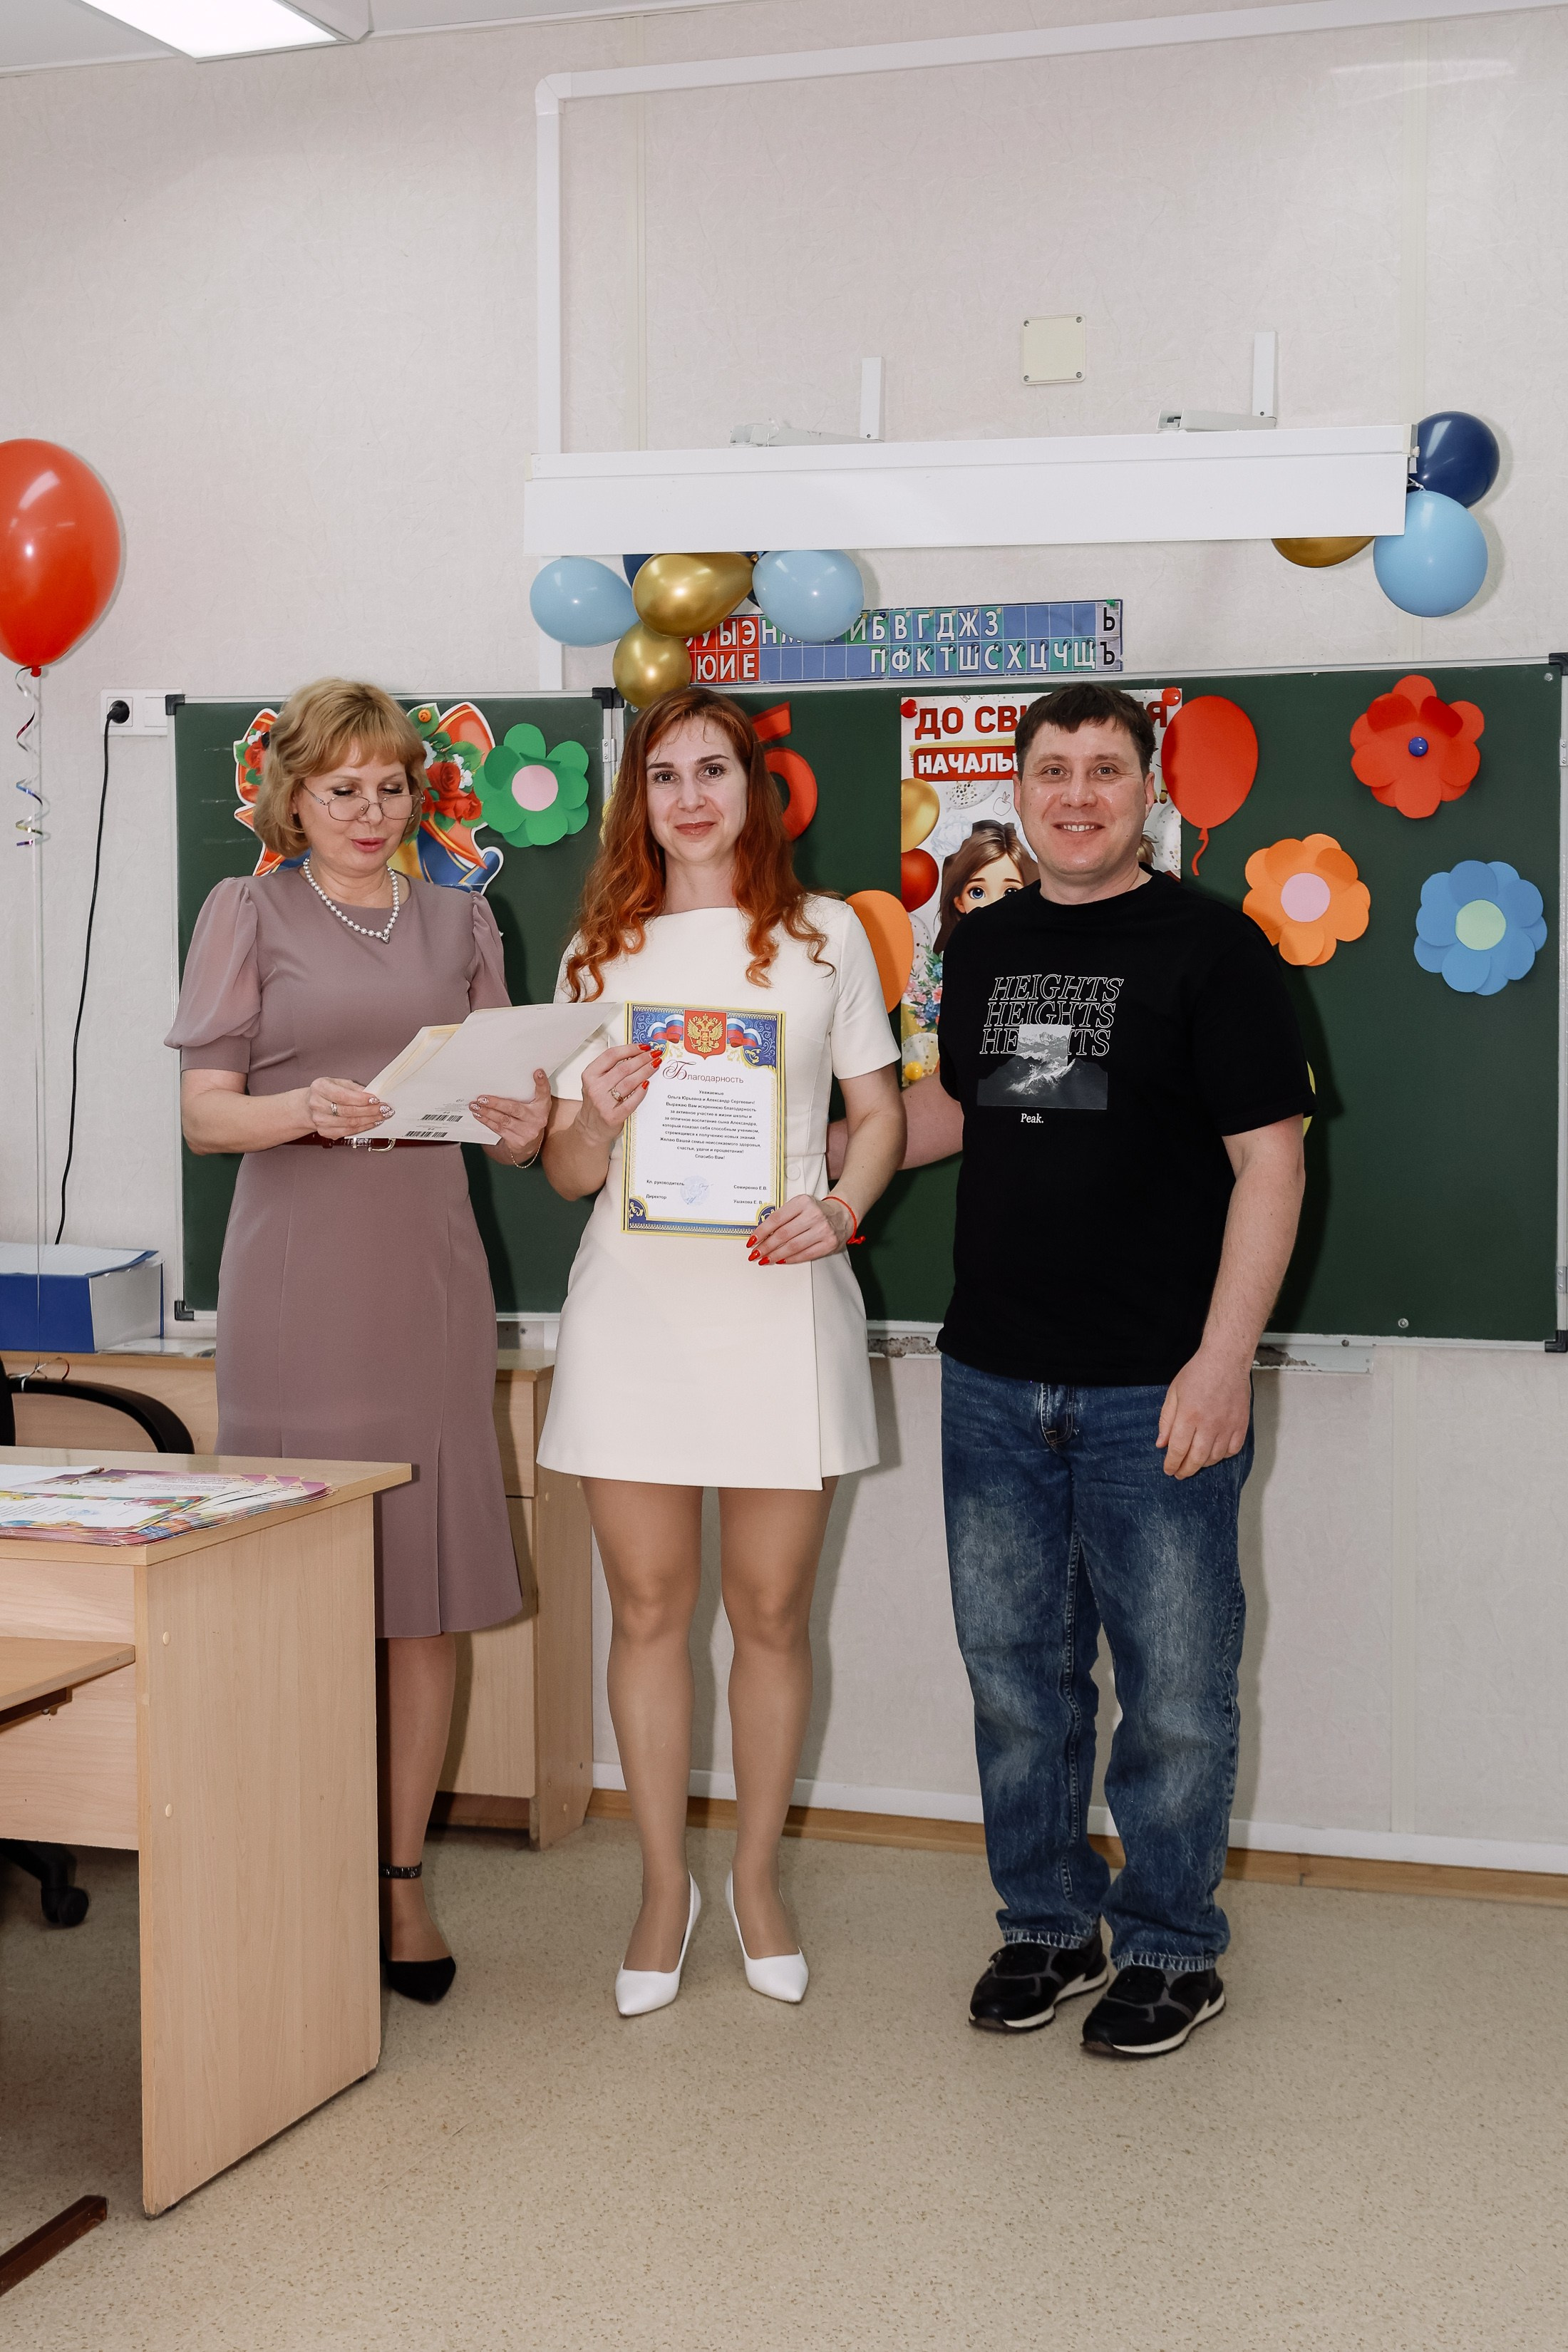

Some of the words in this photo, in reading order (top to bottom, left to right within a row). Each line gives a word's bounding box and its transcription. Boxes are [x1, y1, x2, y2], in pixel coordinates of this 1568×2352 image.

[719, 621, 737, 646] Ы
[741, 619, 756, 646] Э
[761, 619, 778, 645] Н
[872, 615, 886, 641] Б
[894, 614, 908, 640] В
[917, 613, 930, 639] Г
[937, 612, 955, 641] Д
[958, 610, 980, 638] Ж
[984, 610, 999, 637] З
[1103, 607, 1116, 631] Ь
[696, 654, 717, 681] Ю
[719, 653, 736, 680] И
[743, 653, 756, 679] Е
[870, 649, 887, 674] П
[891, 648, 911, 673] Ф
[916, 646, 932, 672] К
[939, 646, 954, 672] Т
[959, 644, 979, 671] Ш
[984, 644, 999, 670] С
[1006, 643, 1023, 670] Х
[1030, 642, 1048, 671] Ц
[1053, 641, 1068, 668] Ч
[1073, 641, 1096, 670] Щ
[1099, 641, 1116, 666] Ъ
[914, 706, 964, 740] ДО
[989, 974, 1125, 1002] HEIGHTS
[984, 1001, 1116, 1028] HEIGHTS
[979, 1028, 1112, 1056] HETS
[662, 1059, 744, 1083] Благодарность
[1020, 1113, 1044, 1123] Peak.
